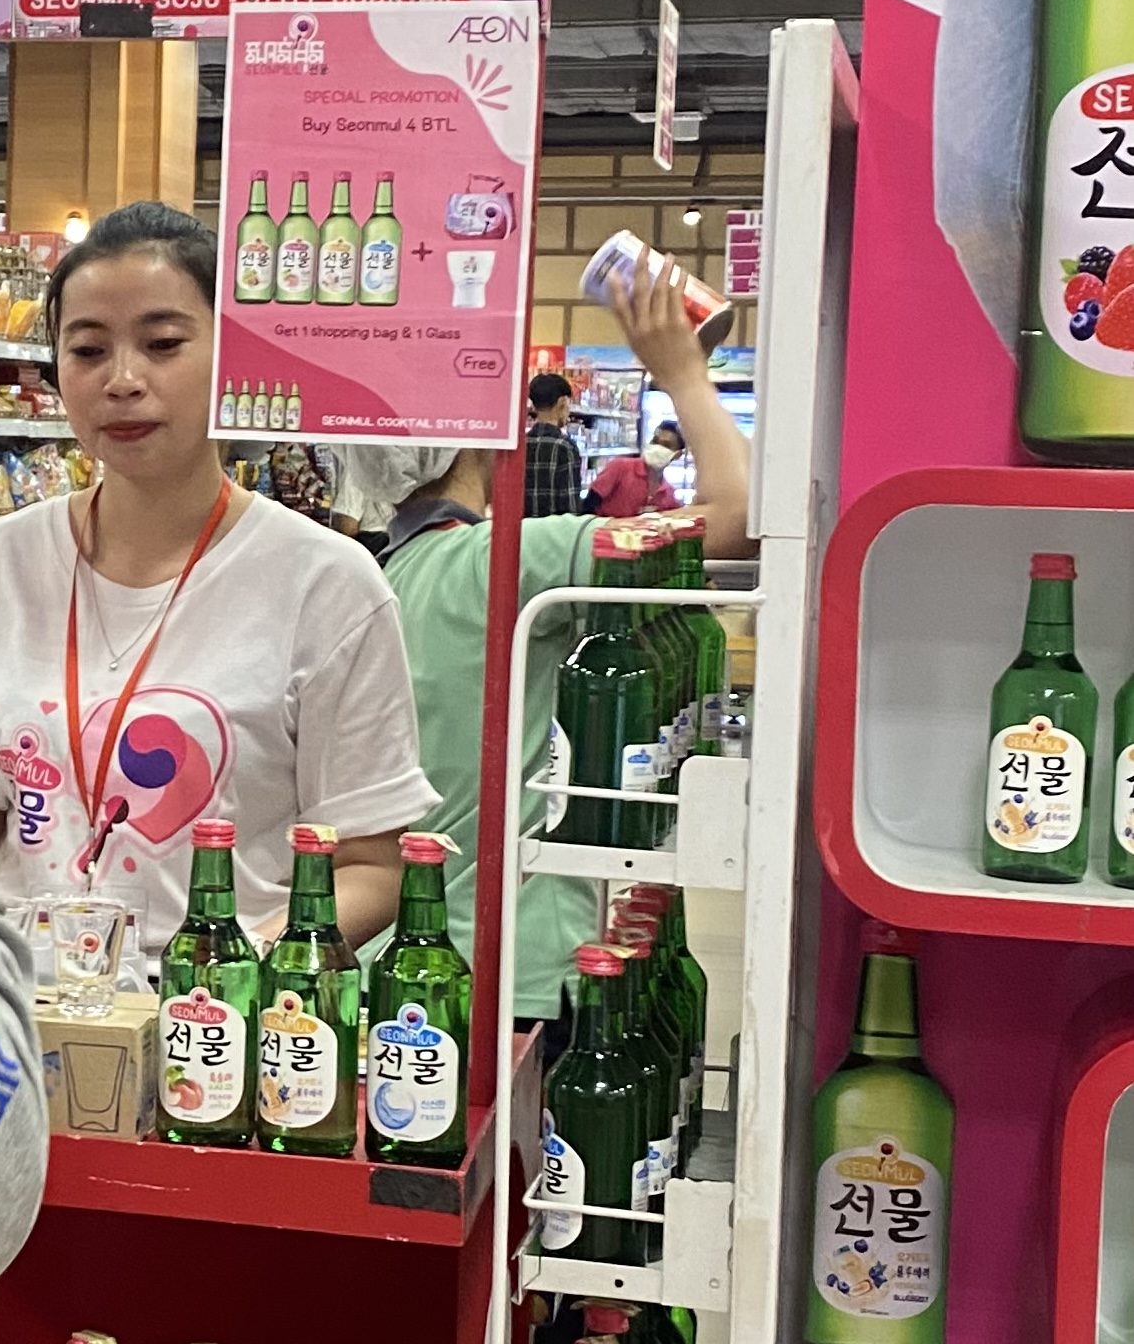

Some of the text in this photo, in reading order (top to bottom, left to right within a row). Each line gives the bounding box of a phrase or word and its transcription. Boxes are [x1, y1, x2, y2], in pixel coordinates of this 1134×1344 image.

[303, 89, 460, 104] SPECIAL PROMOTION
[302, 117, 457, 134] Buy Seonmul 4 BTL
[274, 324, 299, 338] Get
[310, 325, 369, 341] shopping
[372, 325, 398, 342] bag
[402, 326, 413, 339] &
[425, 327, 461, 340] Glass
[463, 356, 497, 371] Free
[171, 1005, 224, 1022] SEONMUL
